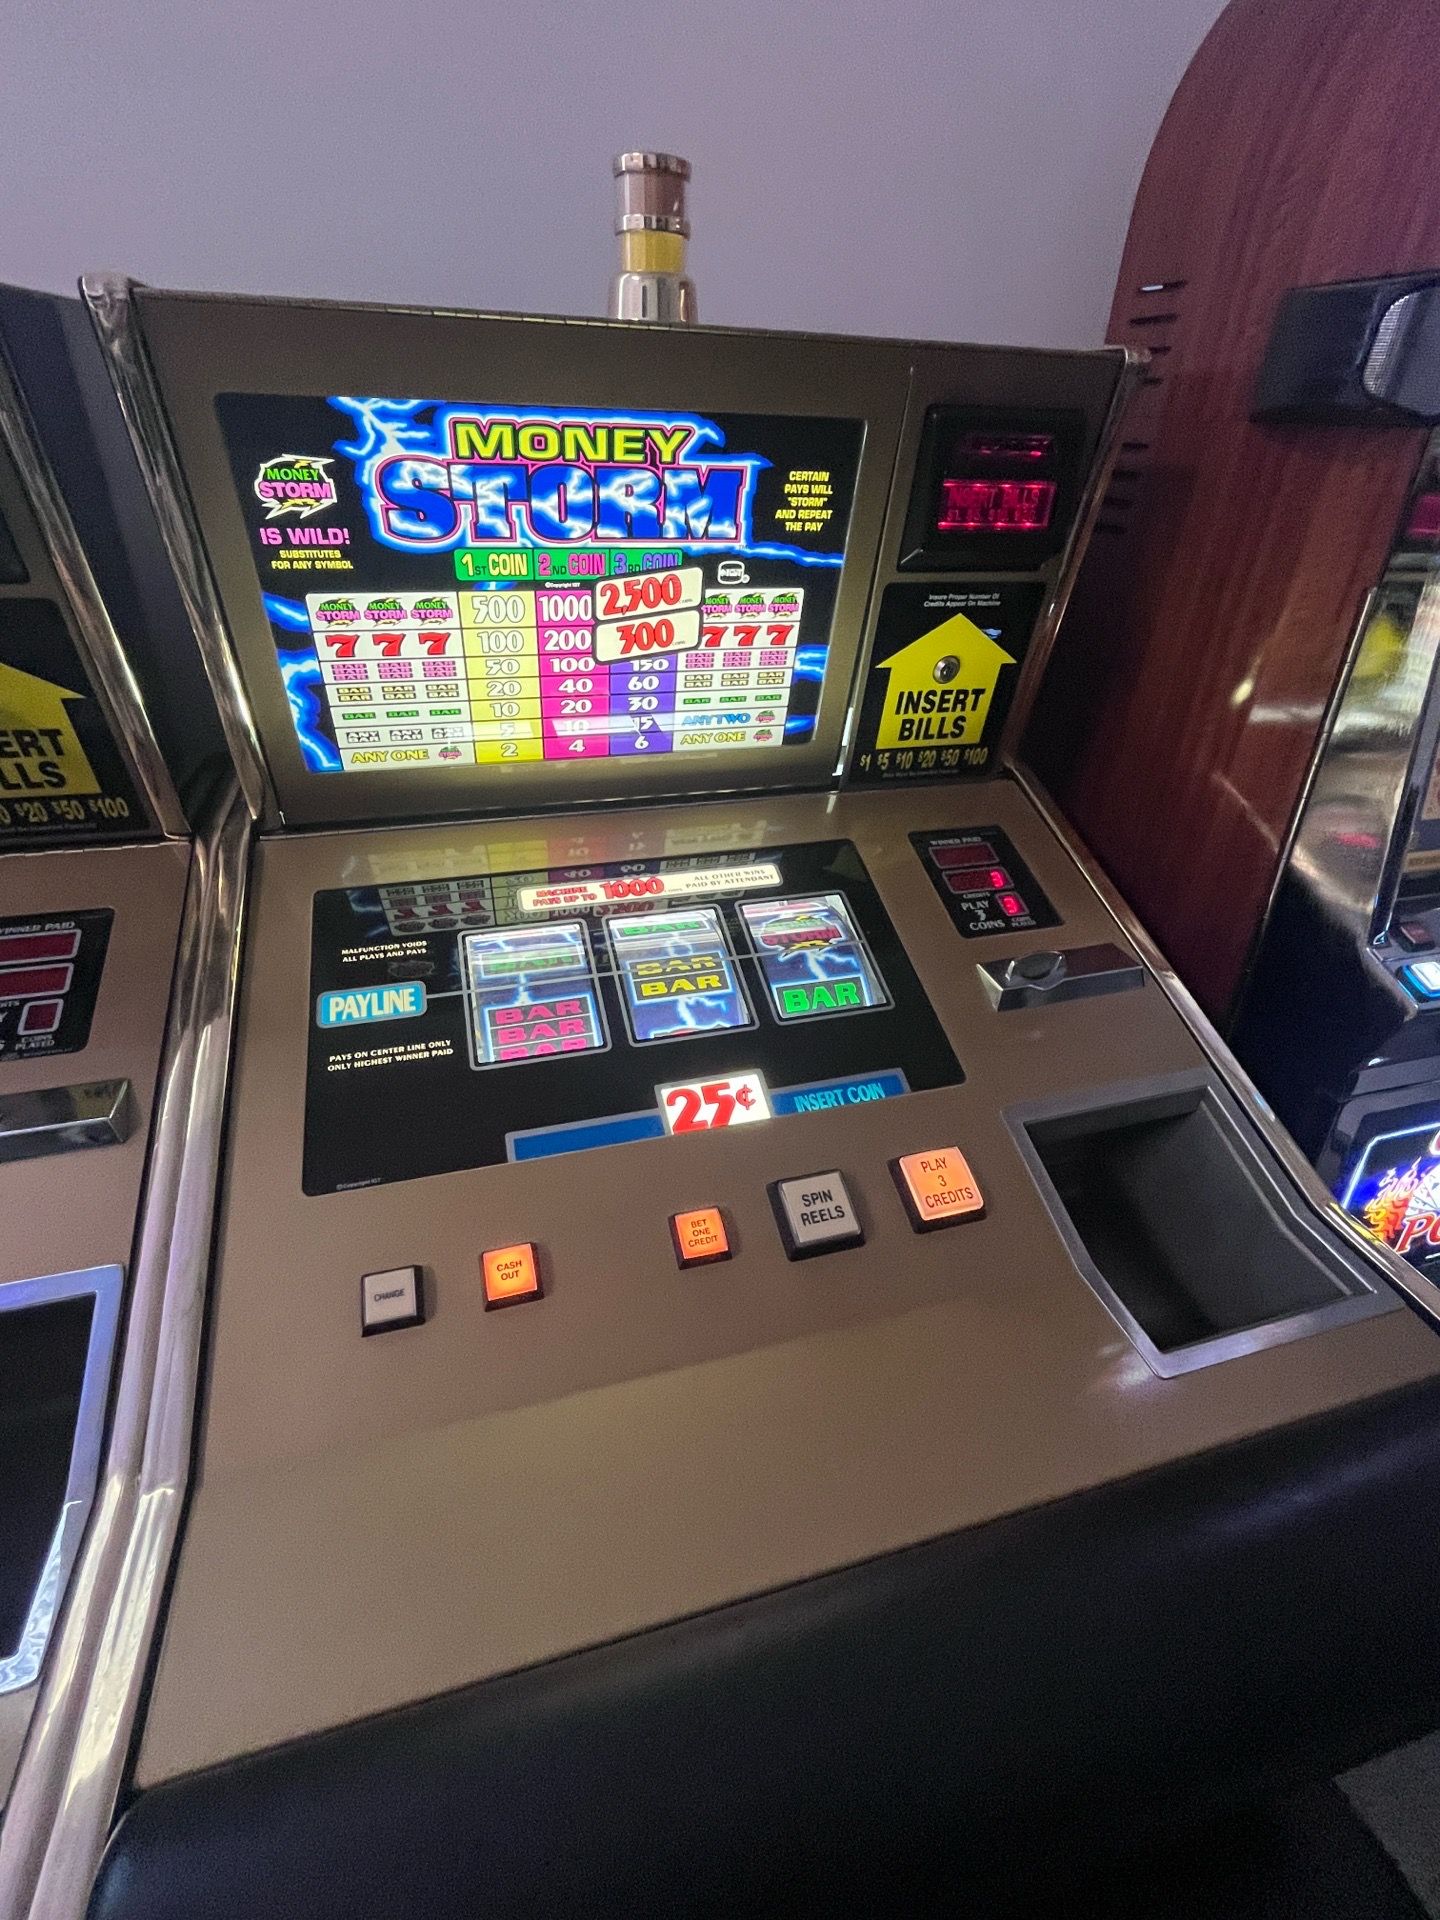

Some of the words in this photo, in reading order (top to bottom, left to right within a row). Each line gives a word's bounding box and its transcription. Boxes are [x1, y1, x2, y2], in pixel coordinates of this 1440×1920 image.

[454, 422, 693, 463] MONEY
[266, 468, 319, 480] MONEY
[789, 470, 830, 482] CERTAIN
[259, 481, 333, 498] STORM
[784, 484, 809, 494] PAYS
[811, 484, 833, 495] WILL
[377, 457, 745, 541] STORM
[787, 496, 828, 507] "STORM"
[775, 509, 796, 519] AND
[798, 509, 833, 520] REPEAT
[785, 521, 803, 531] THE
[804, 521, 823, 532] PAY
[260, 528, 282, 545] IS
[287, 528, 351, 545] WILD!
[279, 549, 341, 559] SUBSTITUTES
[271, 560, 290, 570] FOR
[292, 560, 312, 570] ANY
[314, 560, 354, 571] SYMBOL
[488, 553, 528, 576] COIN
[568, 553, 605, 576] COIN
[600, 573, 682, 616] 2,500
[321, 602, 353, 610] MONEY
[369, 602, 401, 610] MONEY
[415, 601, 447, 609] MONEY
[471, 595, 526, 624] 500
[539, 595, 592, 622] 1000
[701, 604, 732, 613] STORM
[735, 604, 766, 613] STORM
[768, 603, 799, 612] STORM
[316, 610, 361, 620] STORM
[364, 609, 407, 620] STORM
[411, 609, 453, 619] STORM
[477, 630, 525, 653] 100
[543, 629, 592, 650] 200
[616, 619, 675, 654] 300
[703, 626, 729, 647] 7
[733, 625, 762, 646] 7
[767, 624, 795, 646] 7
[325, 634, 360, 658] 7
[372, 633, 407, 656] 7
[418, 632, 451, 655] 7
[485, 659, 520, 676] 50
[550, 657, 595, 672] 100
[630, 658, 669, 672] 150
[487, 680, 522, 697] 20
[558, 678, 593, 693] 40
[628, 676, 660, 691] 60
[490, 702, 520, 717] 10
[560, 699, 593, 714] 20
[629, 696, 659, 711] 30
[895, 688, 986, 715] INSERT
[681, 714, 713, 726] ANY
[712, 712, 752, 724] TWO
[898, 716, 967, 742] BILLS
[501, 743, 518, 757] 2
[568, 739, 586, 753] 4
[634, 736, 649, 749] 6
[680, 733, 713, 745] ANY
[714, 731, 746, 742] ONE
[351, 751, 389, 763] ANY
[391, 748, 430, 761] ONE
[860, 753, 872, 772] $1
[877, 752, 891, 770] $5
[896, 751, 914, 769] $10
[918, 750, 937, 769] $20
[940, 749, 960, 767] $50
[963, 747, 988, 765] $100
[14, 802, 48, 823] $20
[52, 799, 85, 820] $50
[89, 797, 130, 817] $100
[599, 875, 665, 899] 1000
[685, 881, 708, 889] PAID
[724, 874, 774, 884] ATTENDANT
[533, 896, 561, 907] PAYS
[563, 895, 580, 903] UP
[581, 893, 597, 902] TO
[536, 886, 588, 898] MACHINE
[960, 900, 990, 911] PLAY
[624, 921, 699, 935] BAR
[969, 919, 1006, 930] COINS
[341, 943, 400, 955] MALFUNCTION
[402, 940, 428, 948] VOIDS
[342, 955, 358, 963] ALL
[360, 953, 385, 961] PLAYS
[386, 950, 405, 958] AND
[406, 948, 427, 956] PAYS
[636, 956, 716, 975] BAR
[641, 974, 722, 996] BAR
[329, 988, 416, 1022] PAYLINE
[783, 982, 860, 1013] BAR
[495, 1000, 583, 1025] BAR
[497, 1018, 585, 1045] BAR
[327, 1062, 352, 1072] ONLY
[354, 1057, 392, 1069] HIGHEST
[395, 1051, 430, 1062] WINNER
[431, 1048, 454, 1057] PAID
[329, 1053, 352, 1063] PAYS
[354, 1051, 369, 1059] ON
[370, 1046, 405, 1057] CENTER
[407, 1043, 426, 1052] LINE
[428, 1040, 451, 1049] ONLY
[793, 1091, 845, 1113] INSERT
[846, 1082, 886, 1104] COIN
[666, 1081, 757, 1135] 25¢
[920, 1157, 948, 1174] PLAY
[938, 1174, 947, 1187] 3
[801, 1189, 834, 1207] SPIN
[925, 1187, 974, 1209] CREDITS
[690, 1218, 707, 1229] BET
[801, 1205, 845, 1226] REELS
[692, 1227, 711, 1237] ONE
[688, 1234, 718, 1248] CREDIT
[496, 1259, 522, 1272] CASH
[500, 1269, 520, 1281] OUT
[373, 1287, 405, 1302] CHANGE
